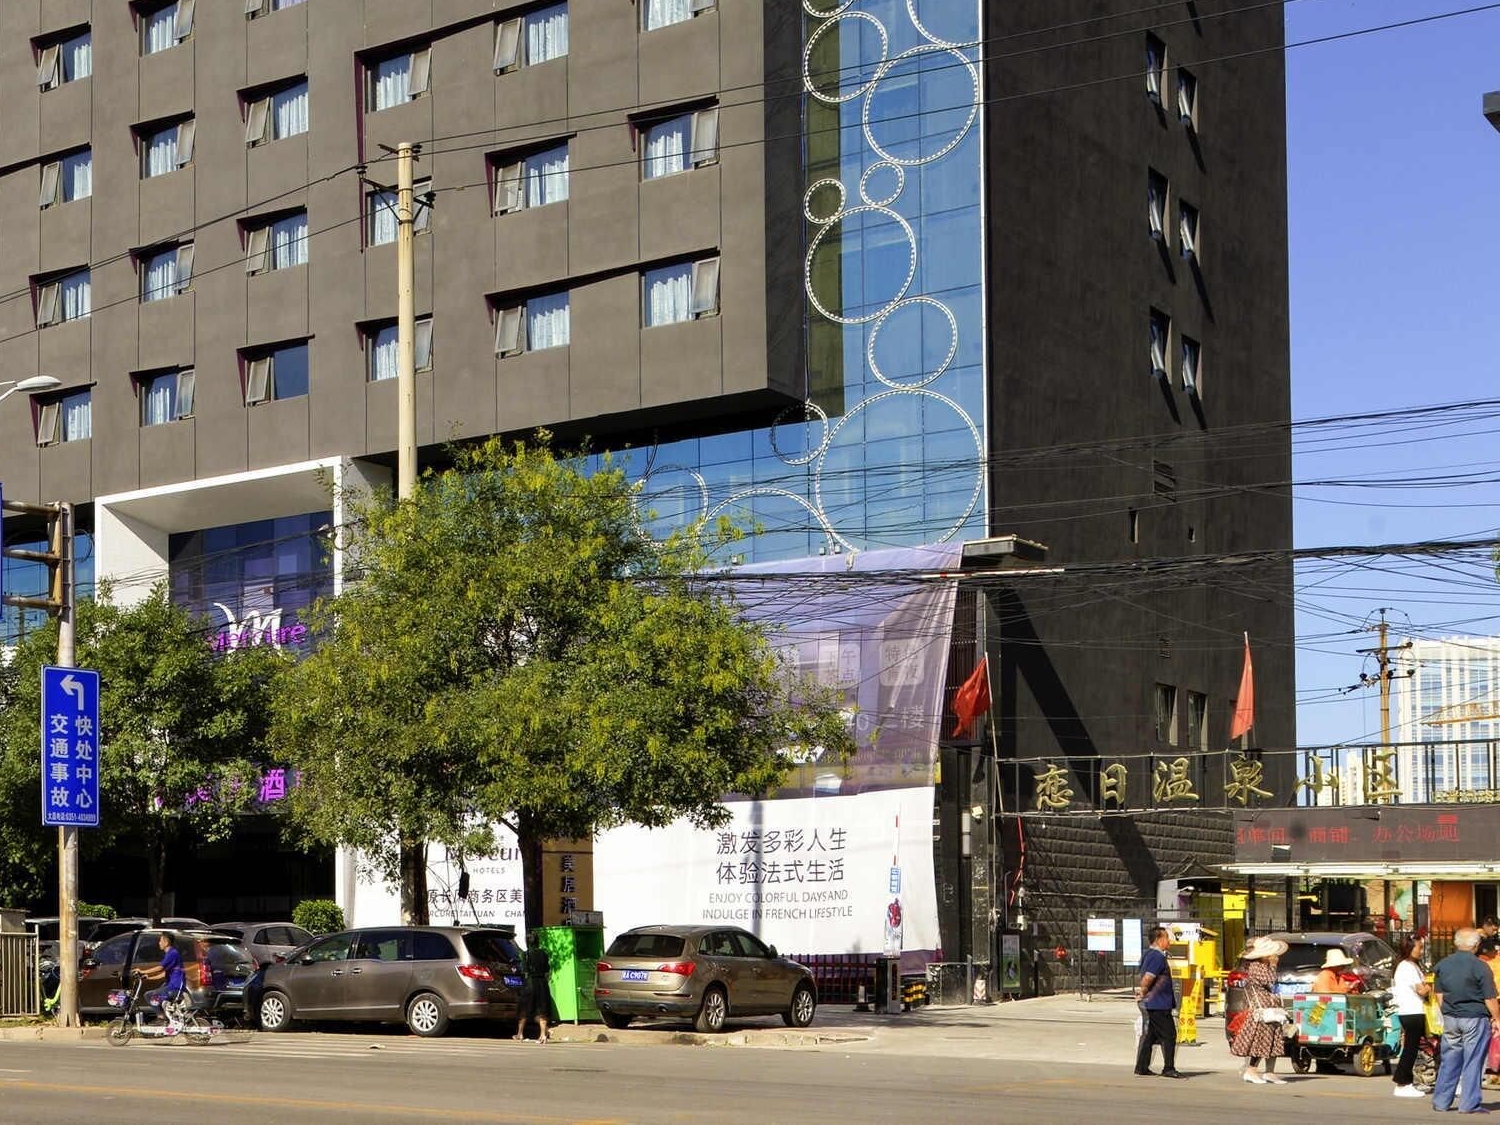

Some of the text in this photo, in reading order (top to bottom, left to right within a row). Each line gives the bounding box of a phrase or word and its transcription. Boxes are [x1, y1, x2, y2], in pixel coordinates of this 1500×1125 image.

[50, 713, 70, 808] 交通事故
[75, 715, 93, 809] 快处中心
[716, 827, 847, 855] 激发多彩人生
[472, 867, 506, 875] HOTELS
[716, 858, 845, 885] 体验法式生活
[709, 892, 743, 904] ENJOY
[745, 891, 799, 904] COLORFUL
[702, 905, 853, 920] INDULGE IN FRENCH LIFESTYLE
